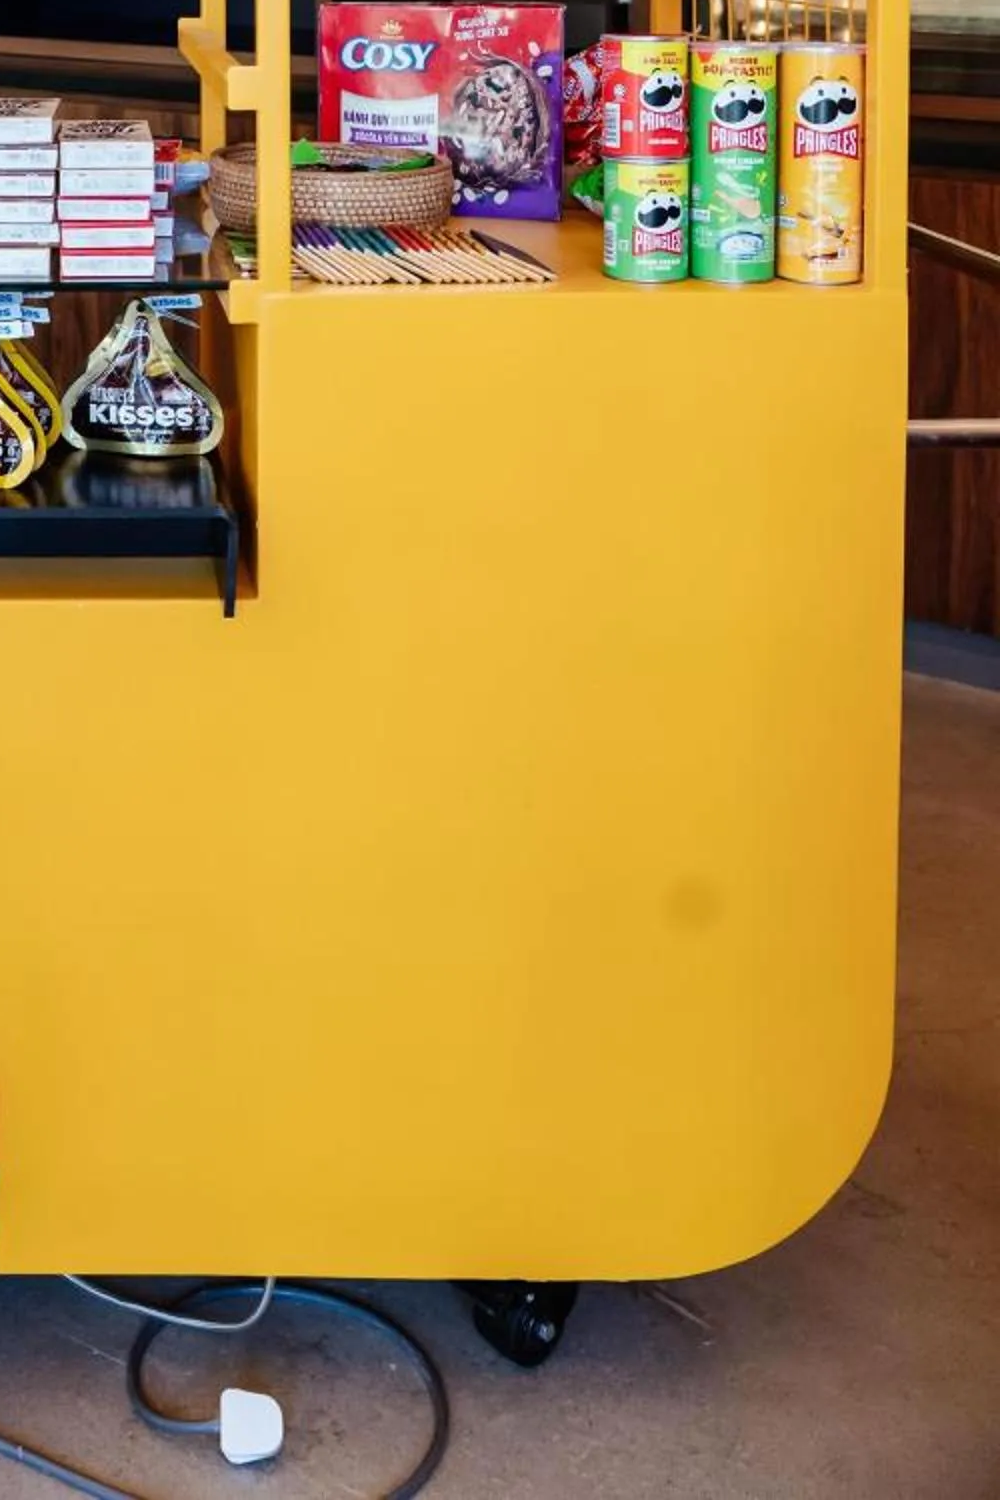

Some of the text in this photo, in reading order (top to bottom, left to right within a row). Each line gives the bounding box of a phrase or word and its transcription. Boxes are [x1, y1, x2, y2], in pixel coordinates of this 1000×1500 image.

[341, 38, 435, 70] COSY
[711, 125, 766, 151] PRINGLES
[796, 127, 857, 156] PRINGLES
